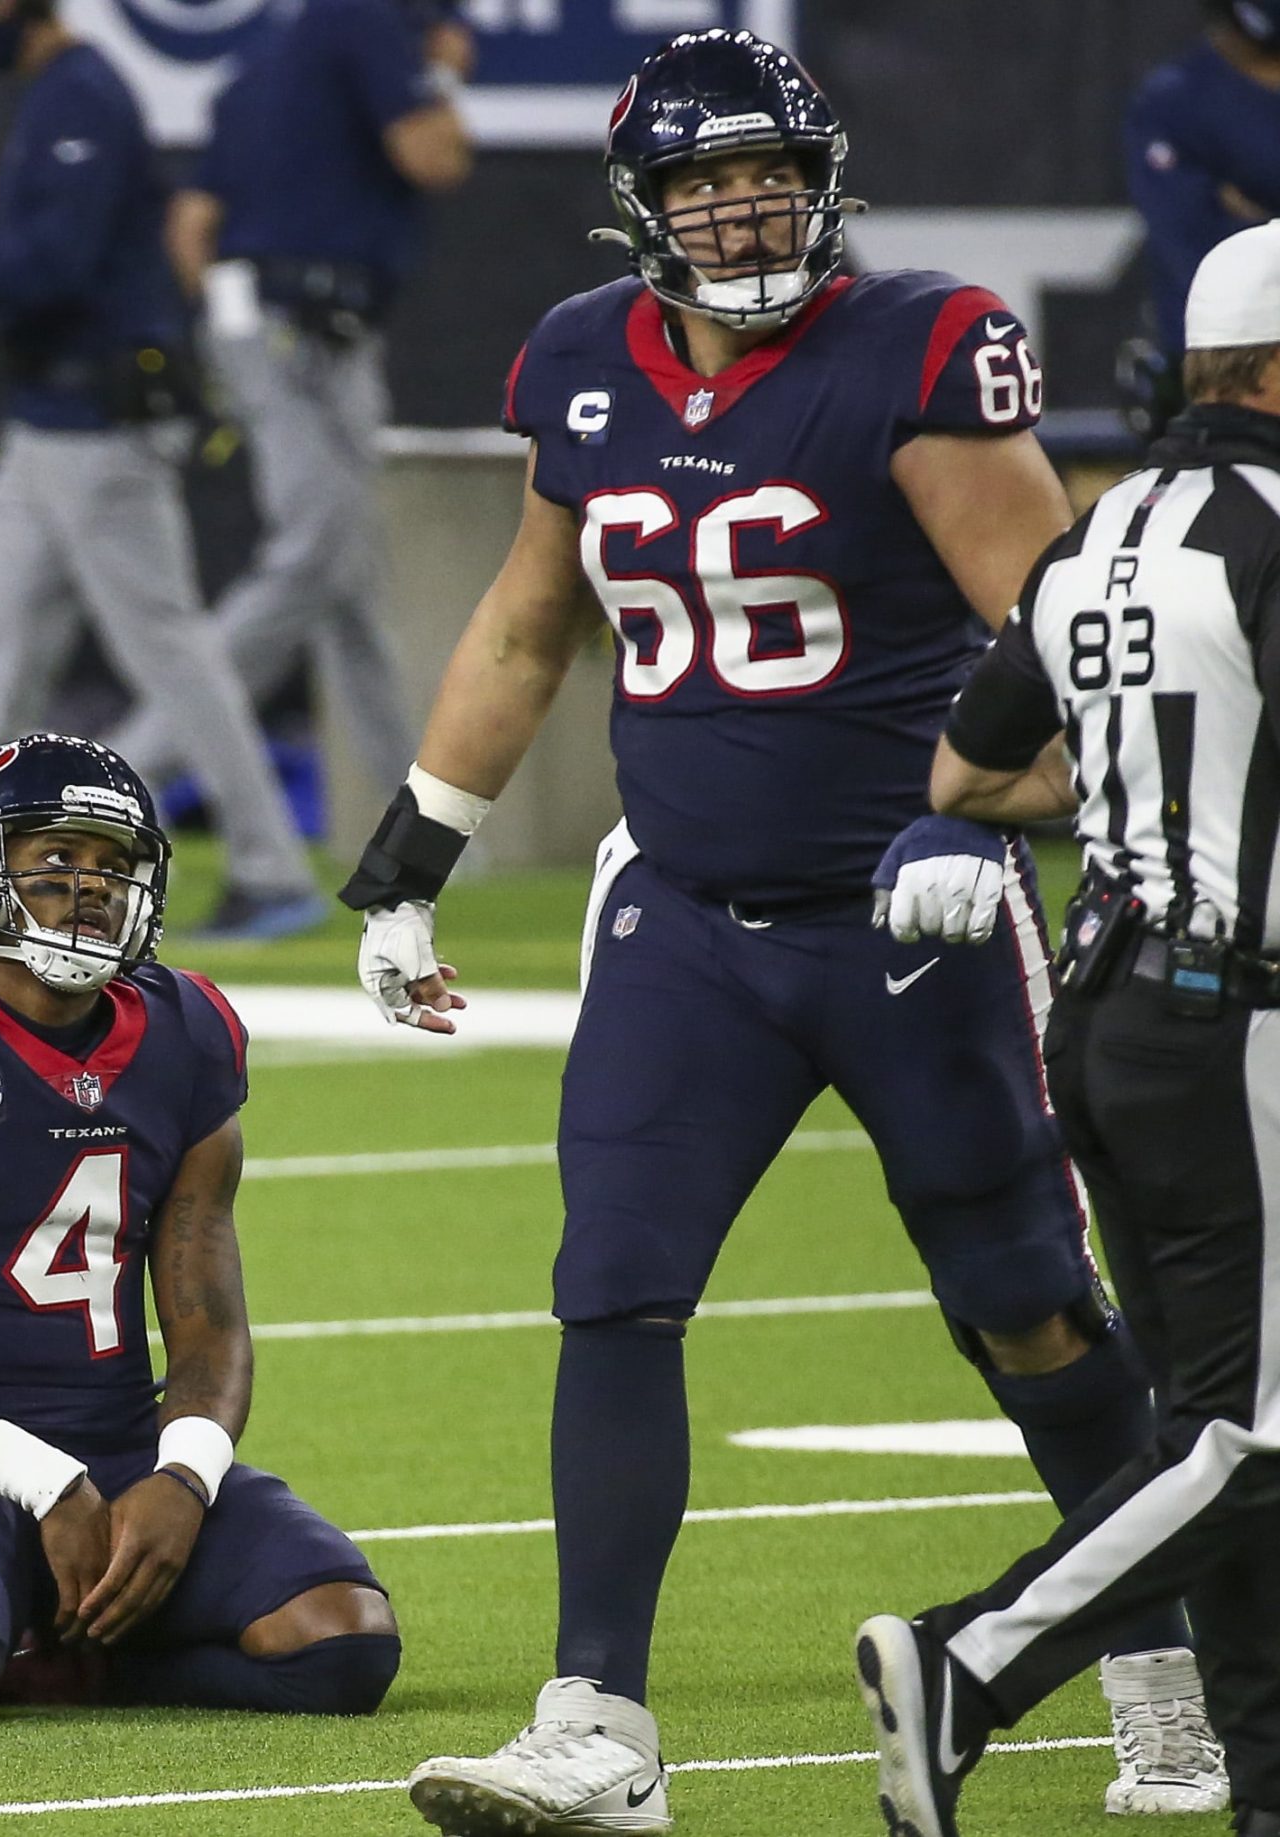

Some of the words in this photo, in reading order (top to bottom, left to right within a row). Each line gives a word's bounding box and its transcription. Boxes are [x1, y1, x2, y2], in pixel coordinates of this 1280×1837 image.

[566, 390, 611, 433] C
[974, 338, 1043, 423] 66
[659, 455, 737, 477] TEXANS
[580, 481, 846, 702] 66
[1105, 555, 1139, 600] R
[1069, 605, 1155, 690] 83
[48, 1125, 129, 1140] TEXANS
[3, 1146, 128, 1358] 4
